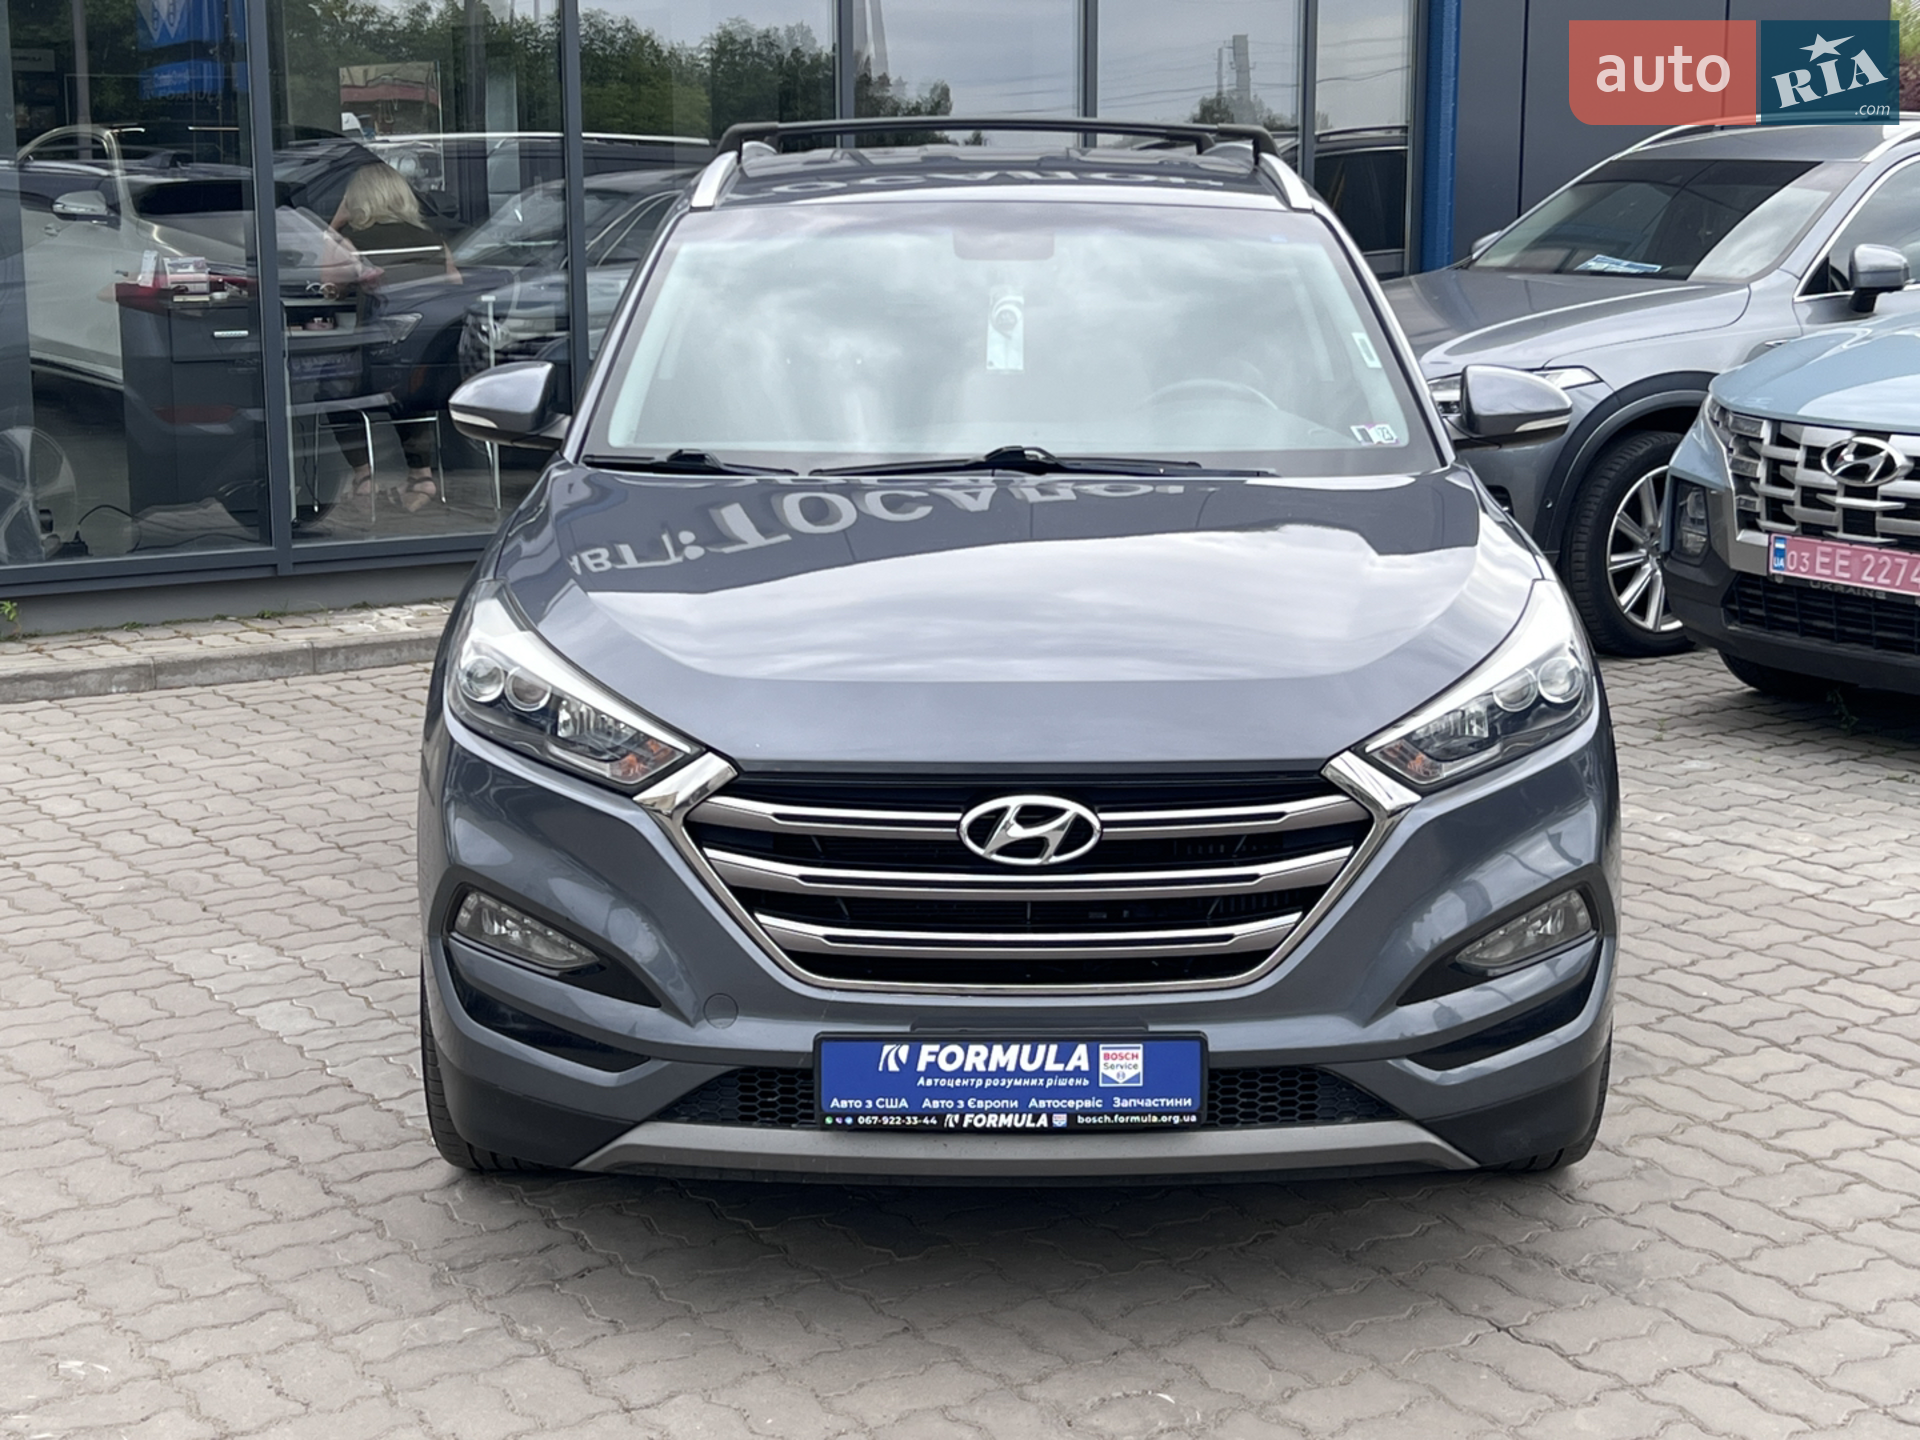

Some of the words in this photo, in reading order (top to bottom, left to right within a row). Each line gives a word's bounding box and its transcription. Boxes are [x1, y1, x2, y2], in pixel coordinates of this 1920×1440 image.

[1774, 558, 1785, 569] UA
[1786, 550, 1811, 573] 03
[1815, 547, 1851, 578] EE
[1809, 581, 1886, 599] UKRAINE
[916, 1044, 1089, 1072] FORMULA
[1103, 1052, 1139, 1061] BOSCH
[1103, 1062, 1139, 1071] Service
[917, 1076, 983, 1088] Автоцентр
[984, 1077, 1044, 1088] розумних
[1045, 1075, 1089, 1088] рішень
[830, 1097, 862, 1110] Авто
[865, 1100, 873, 1109] з
[875, 1097, 909, 1109] США
[922, 1097, 954, 1110] Авто
[957, 1099, 965, 1109] з
[967, 1097, 1018, 1111] Європи
[1028, 1097, 1103, 1111] Автосервіс
[1112, 1096, 1192, 1108] Запчастини
[857, 1115, 938, 1125] 067-922-33-44
[962, 1113, 1048, 1128] FORMULA
[1077, 1114, 1197, 1125] bosch.formula.org.ua
